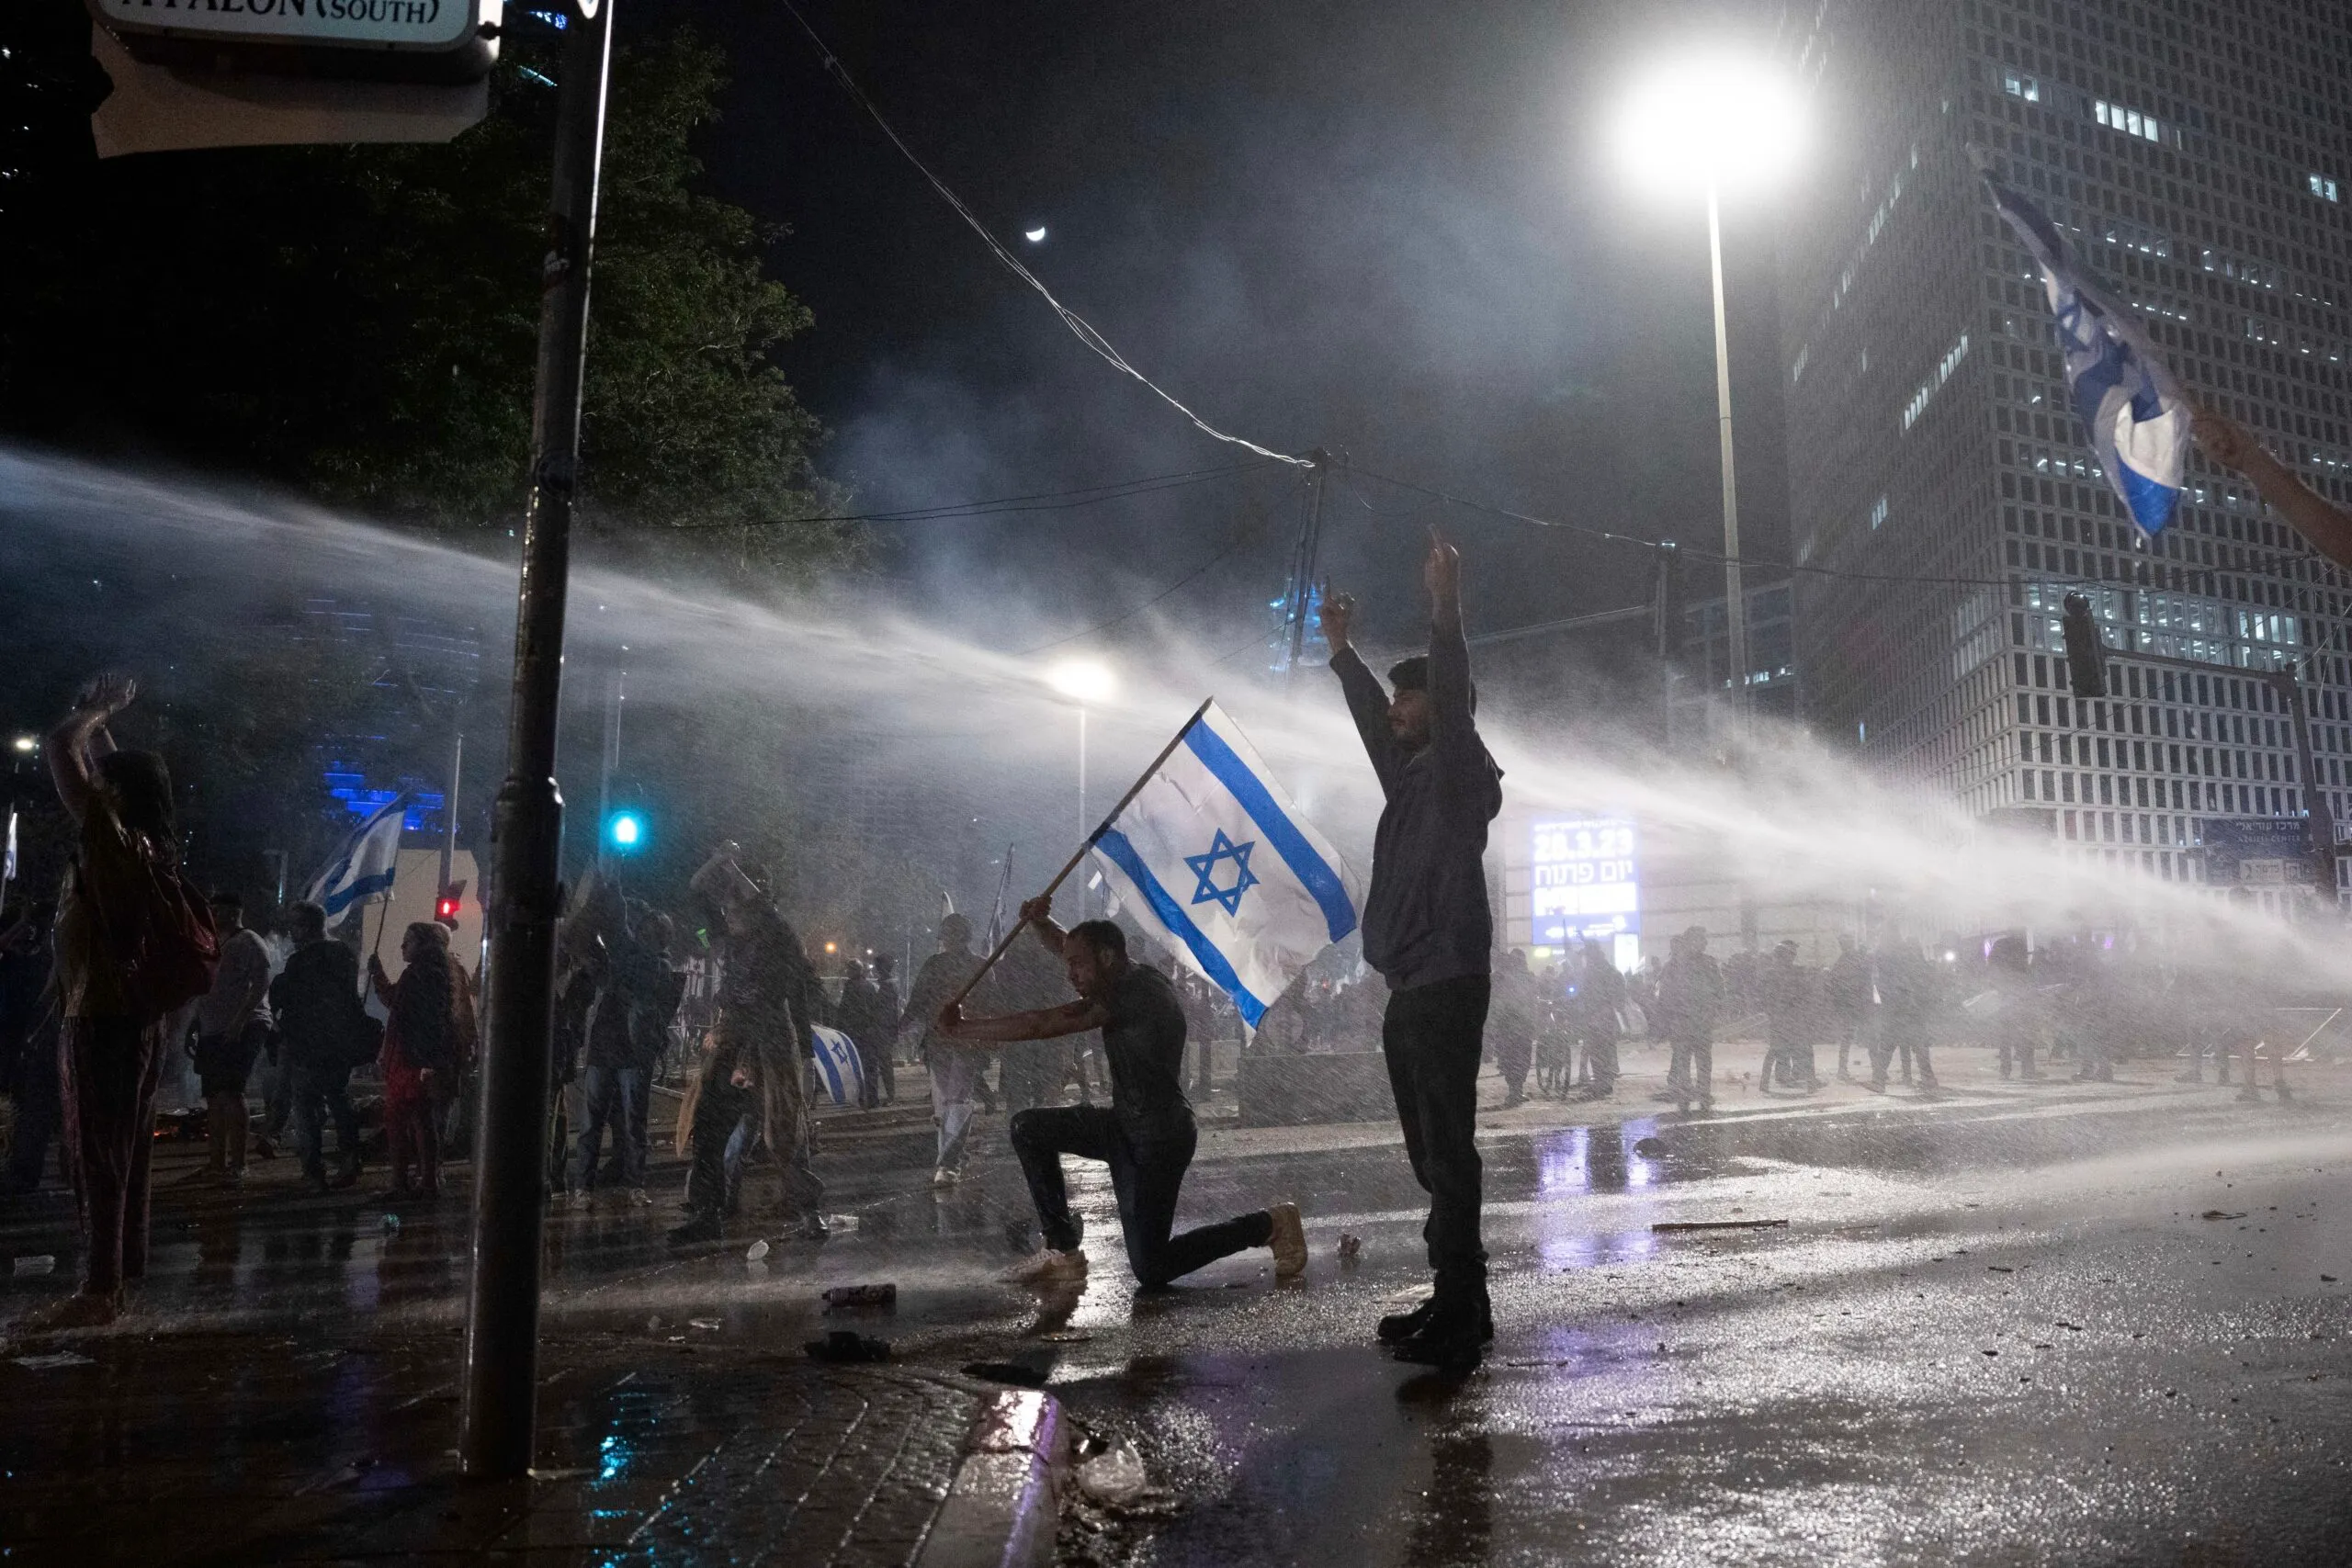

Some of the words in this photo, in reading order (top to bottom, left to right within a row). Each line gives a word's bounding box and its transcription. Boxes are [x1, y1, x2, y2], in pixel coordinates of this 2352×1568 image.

[316, 0, 439, 23] (SOUTH)
[1535, 862, 1594, 886] פתוח
[1600, 860, 1633, 882] יום
